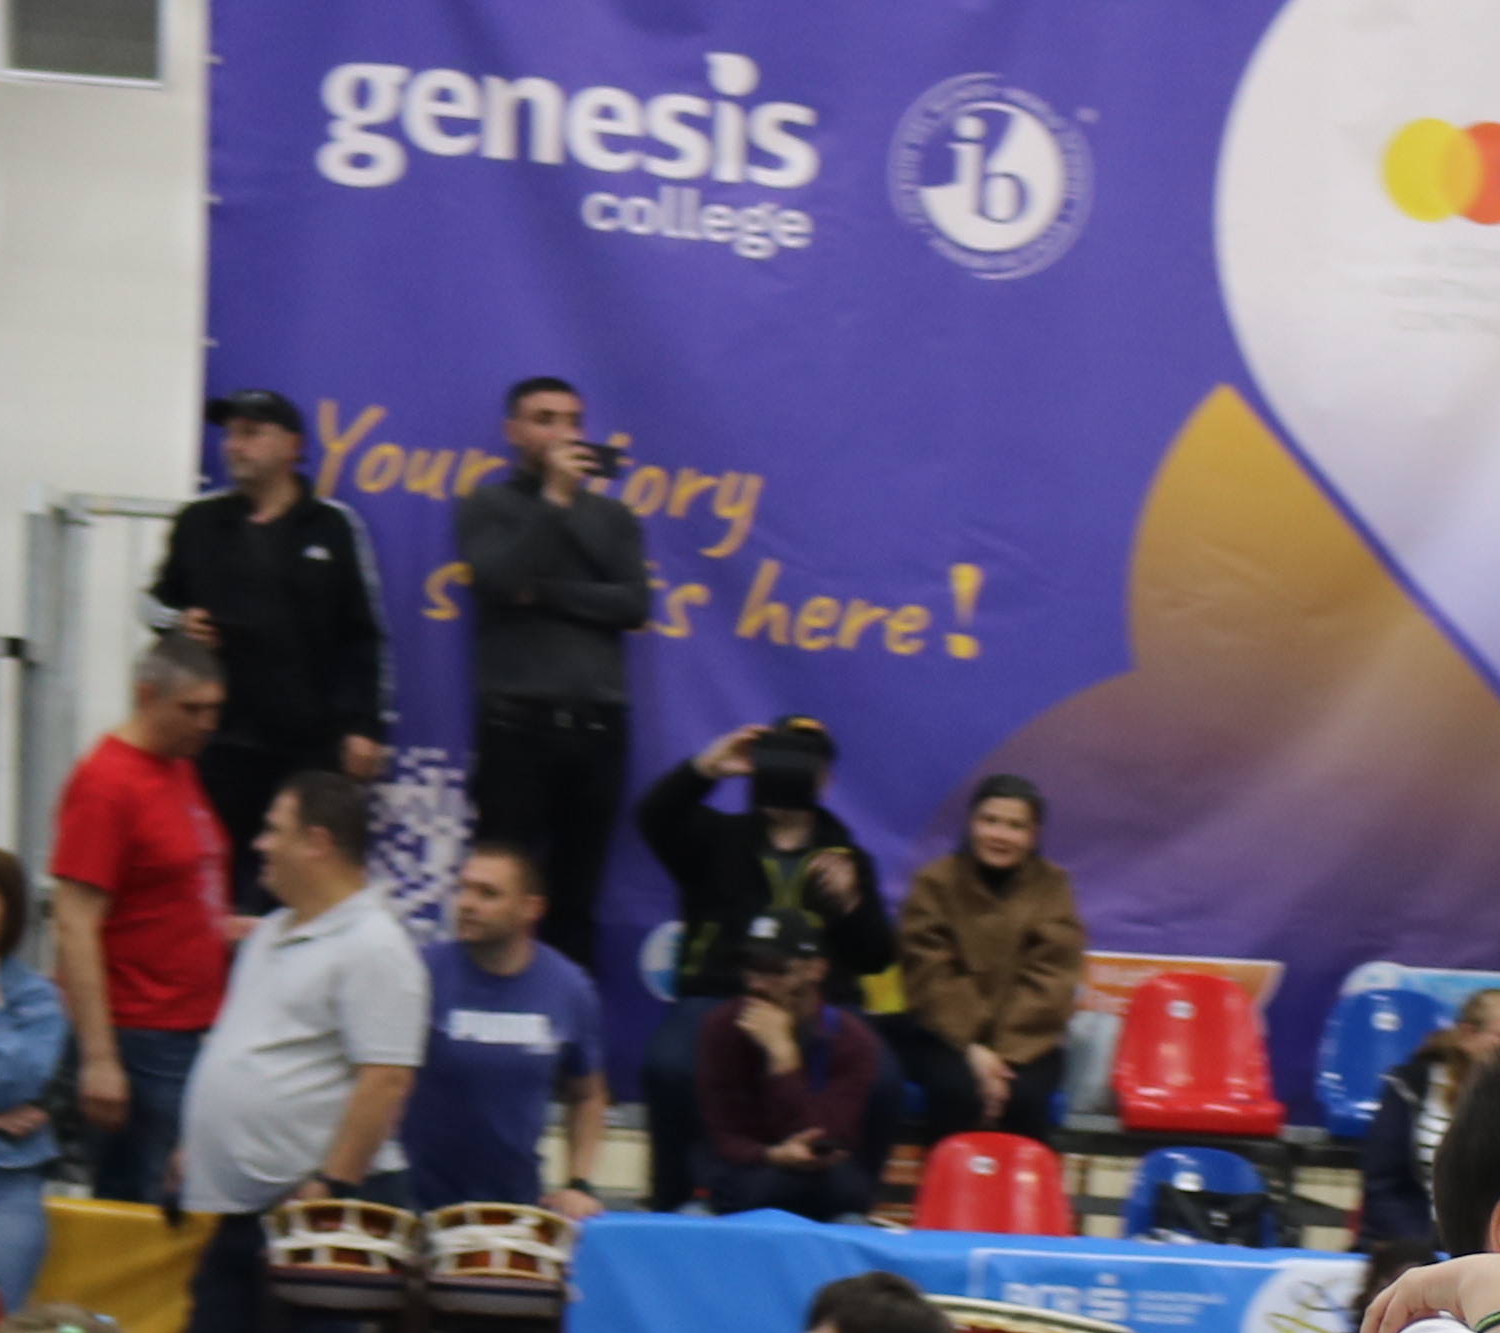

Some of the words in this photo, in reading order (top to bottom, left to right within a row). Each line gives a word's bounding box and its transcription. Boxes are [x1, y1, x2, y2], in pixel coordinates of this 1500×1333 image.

[315, 51, 819, 188] genesis
[580, 185, 815, 260] college
[314, 399, 506, 501] Your
